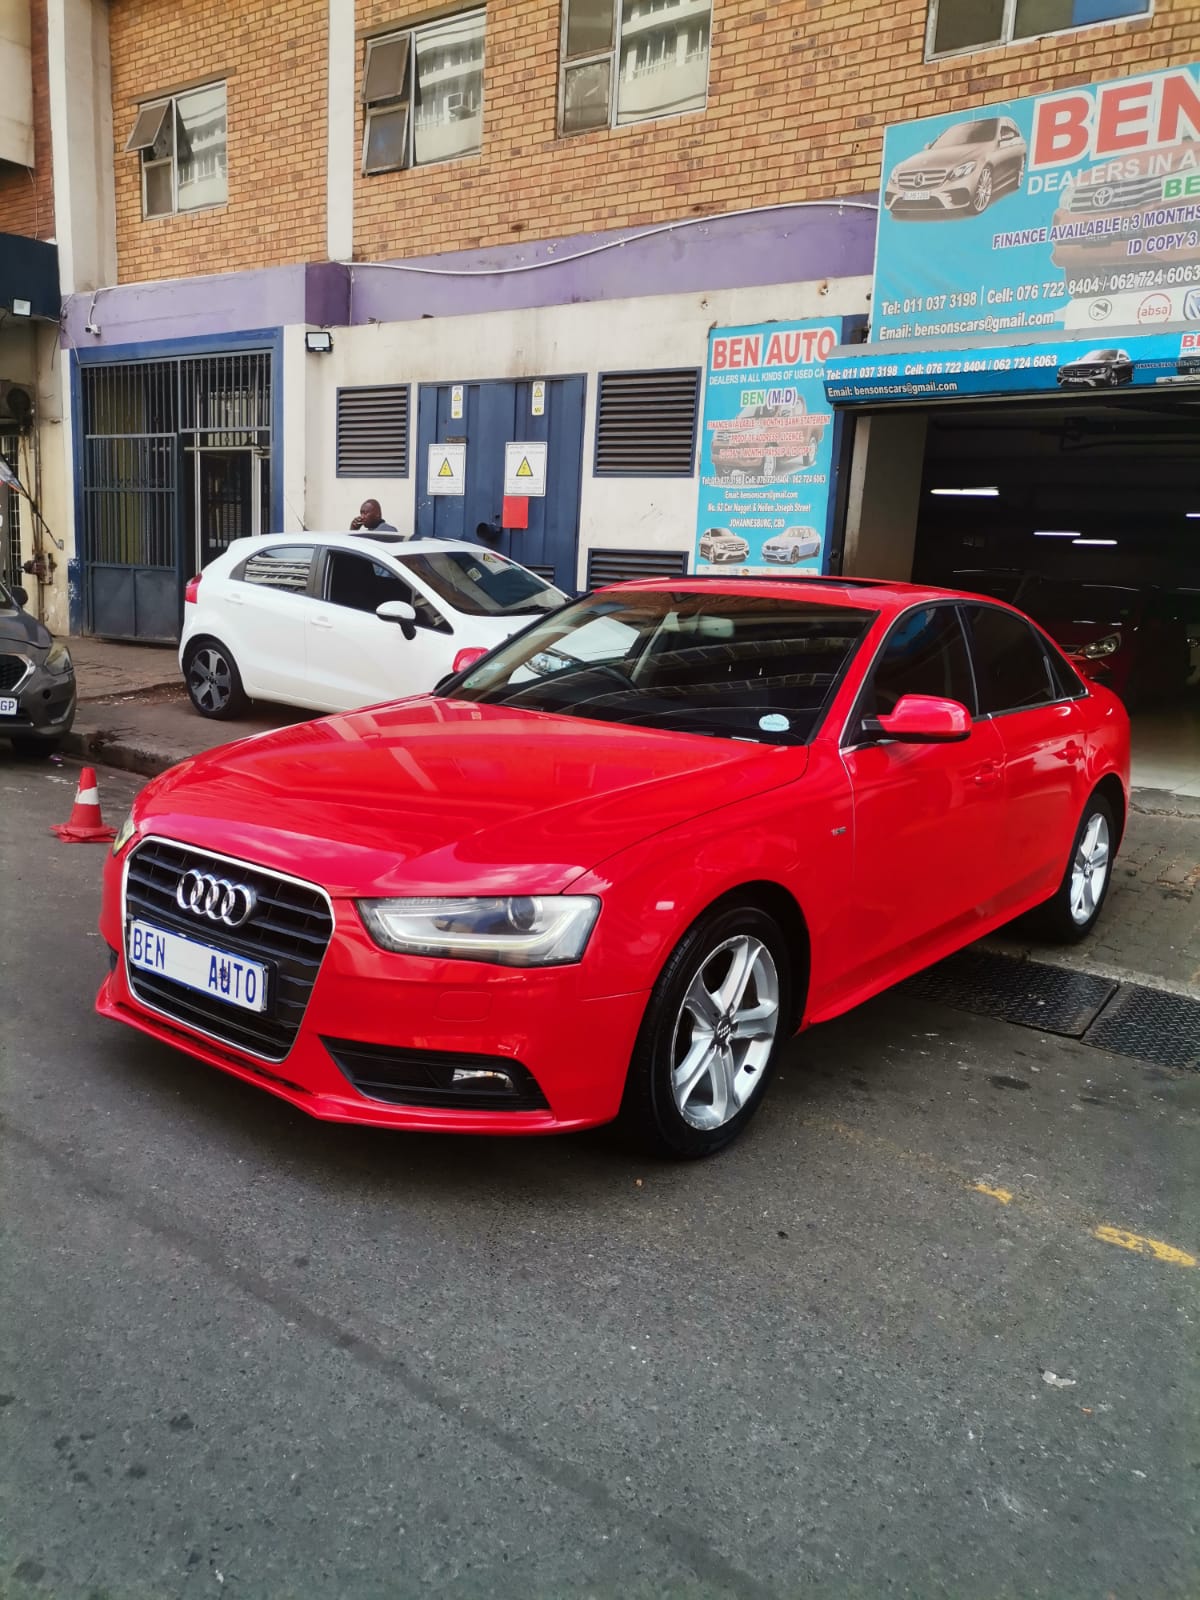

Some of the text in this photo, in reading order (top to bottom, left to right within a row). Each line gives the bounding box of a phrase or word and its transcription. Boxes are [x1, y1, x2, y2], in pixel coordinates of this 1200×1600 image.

[1032, 75, 1200, 166] BEN
[1027, 148, 1200, 195] DEALERS IN A
[992, 227, 1047, 249] FINANCE
[1049, 216, 1121, 241] AVAILABLE
[1131, 213, 1140, 228] 3
[1127, 231, 1197, 255] ID COPY 3
[881, 301, 900, 316] Tel:
[903, 299, 922, 313] 011
[926, 295, 946, 310] 037
[949, 291, 977, 308] 3198
[987, 287, 1013, 304] Cell:
[1016, 284, 1039, 301] 076
[1042, 281, 1065, 297] 722
[1068, 277, 1099, 295] 8404
[1110, 273, 1135, 290] 062
[1139, 269, 1163, 285] 724
[1166, 264, 1200, 282] 6063
[1140, 304, 1168, 318] absa
[879, 312, 1055, 341] Email: bensonscars@gmail.com
[713, 329, 836, 370] BEN AUTO
[709, 374, 739, 385] DEALERS
[739, 373, 747, 383] IN
[747, 373, 761, 383] ALL
[761, 371, 783, 382] KINDS
[783, 370, 794, 380] OF
[794, 369, 813, 380] USED
[826, 369, 841, 381] Tel:
[842, 368, 857, 380] 011
[859, 367, 874, 378] 037
[877, 365, 898, 377] 3198
[904, 364, 924, 376] Cell:
[926, 362, 943, 374] 076
[945, 361, 961, 373] 722
[963, 360, 986, 372] 8404
[993, 357, 1011, 370] 062
[1013, 355, 1030, 369] 724
[1033, 354, 1058, 368] 6063
[741, 390, 765, 406] BEN
[827, 381, 958, 397] Email: bensonscars@gmail.com
[774, 503, 794, 514] Joseph
[794, 503, 811, 512] Street
[0, 700, 15, 711] GP
[133, 928, 257, 1003] BEN AUTO
